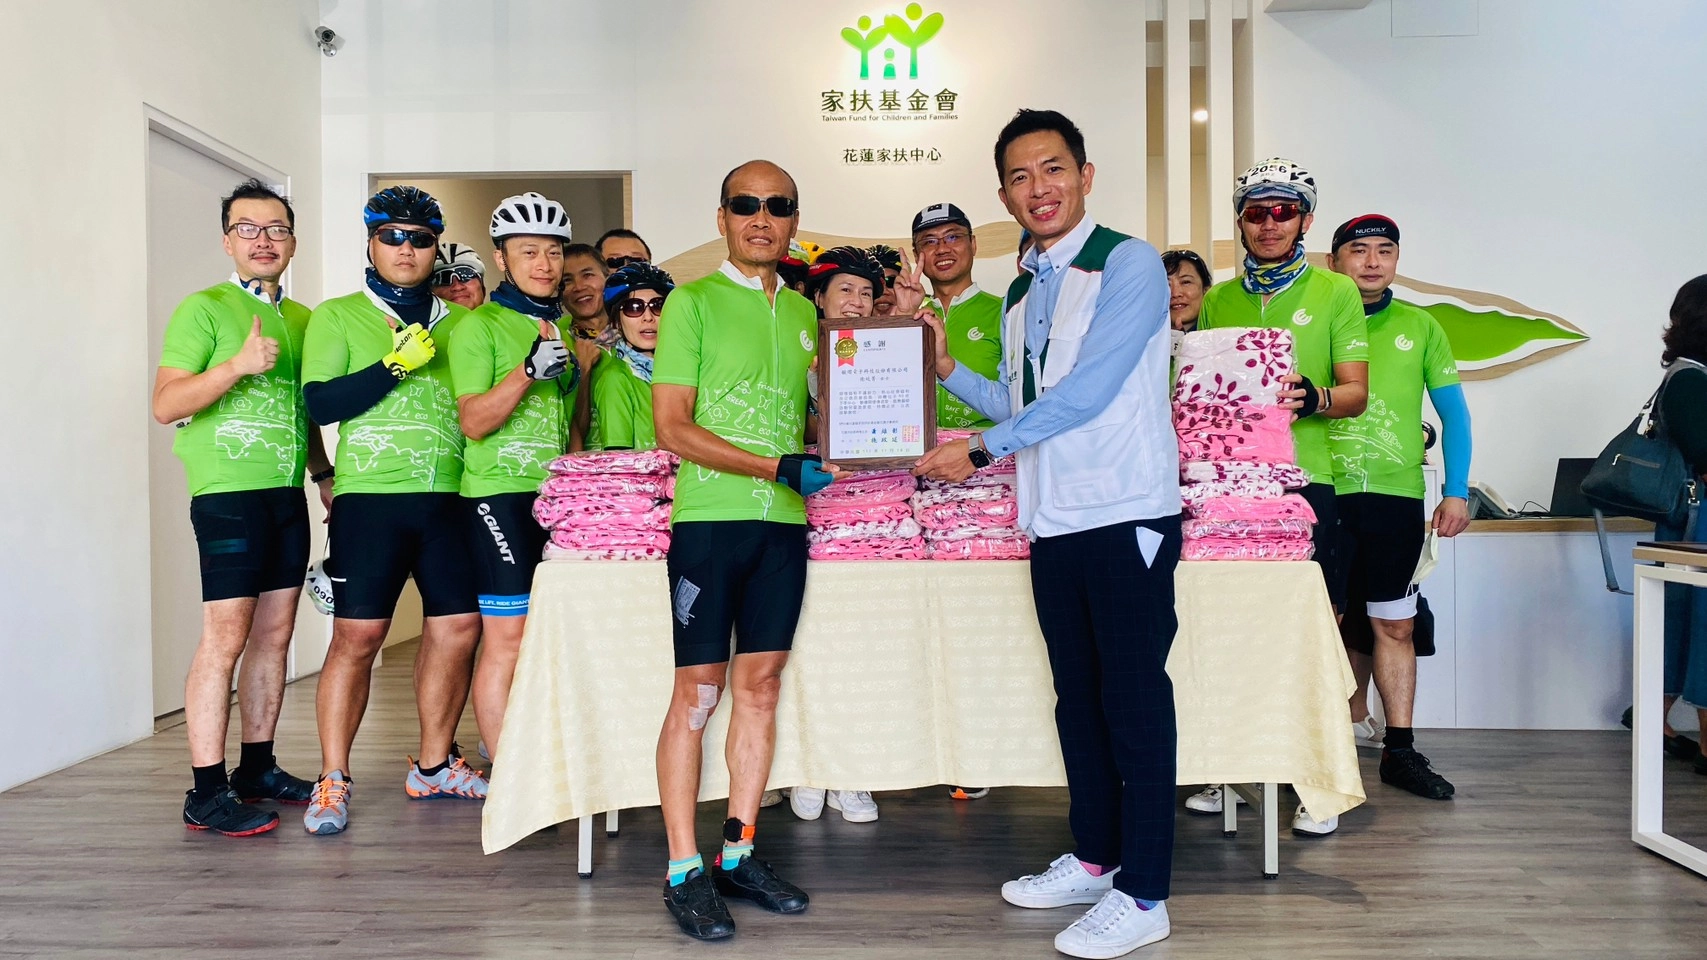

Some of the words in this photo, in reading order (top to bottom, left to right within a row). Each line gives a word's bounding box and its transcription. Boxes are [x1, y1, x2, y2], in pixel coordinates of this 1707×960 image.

[821, 88, 958, 112] 家扶基金會
[843, 147, 942, 163] 花蓮家扶中心
[1250, 165, 1287, 177] 2056
[248, 387, 269, 399] GREEN
[725, 393, 748, 408] GREEN
[944, 404, 961, 414] SAVE
[483, 514, 516, 565] GIANT
